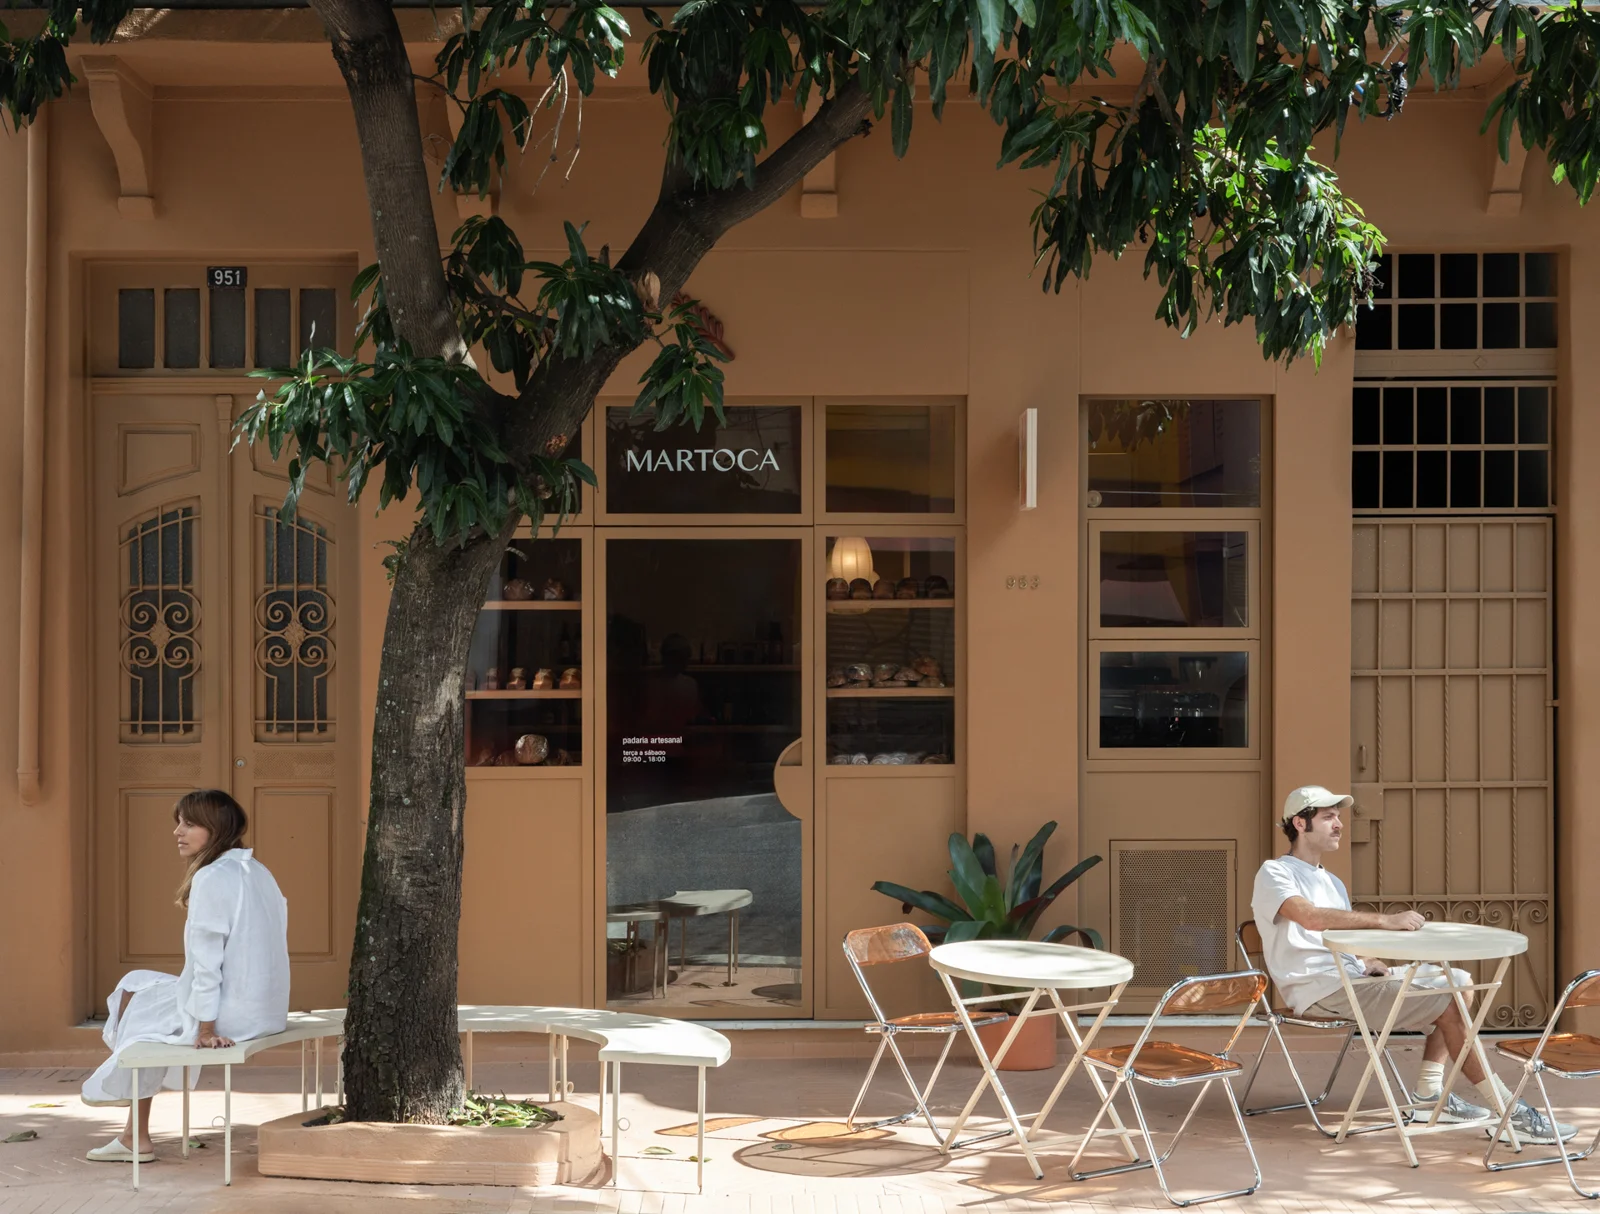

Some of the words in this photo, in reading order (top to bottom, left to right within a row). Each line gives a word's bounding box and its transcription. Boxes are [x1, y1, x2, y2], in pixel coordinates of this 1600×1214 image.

[214, 270, 240, 285] 951
[626, 448, 780, 472] MARTOCA
[622, 736, 649, 745] padaria
[650, 736, 683, 744] artesanal
